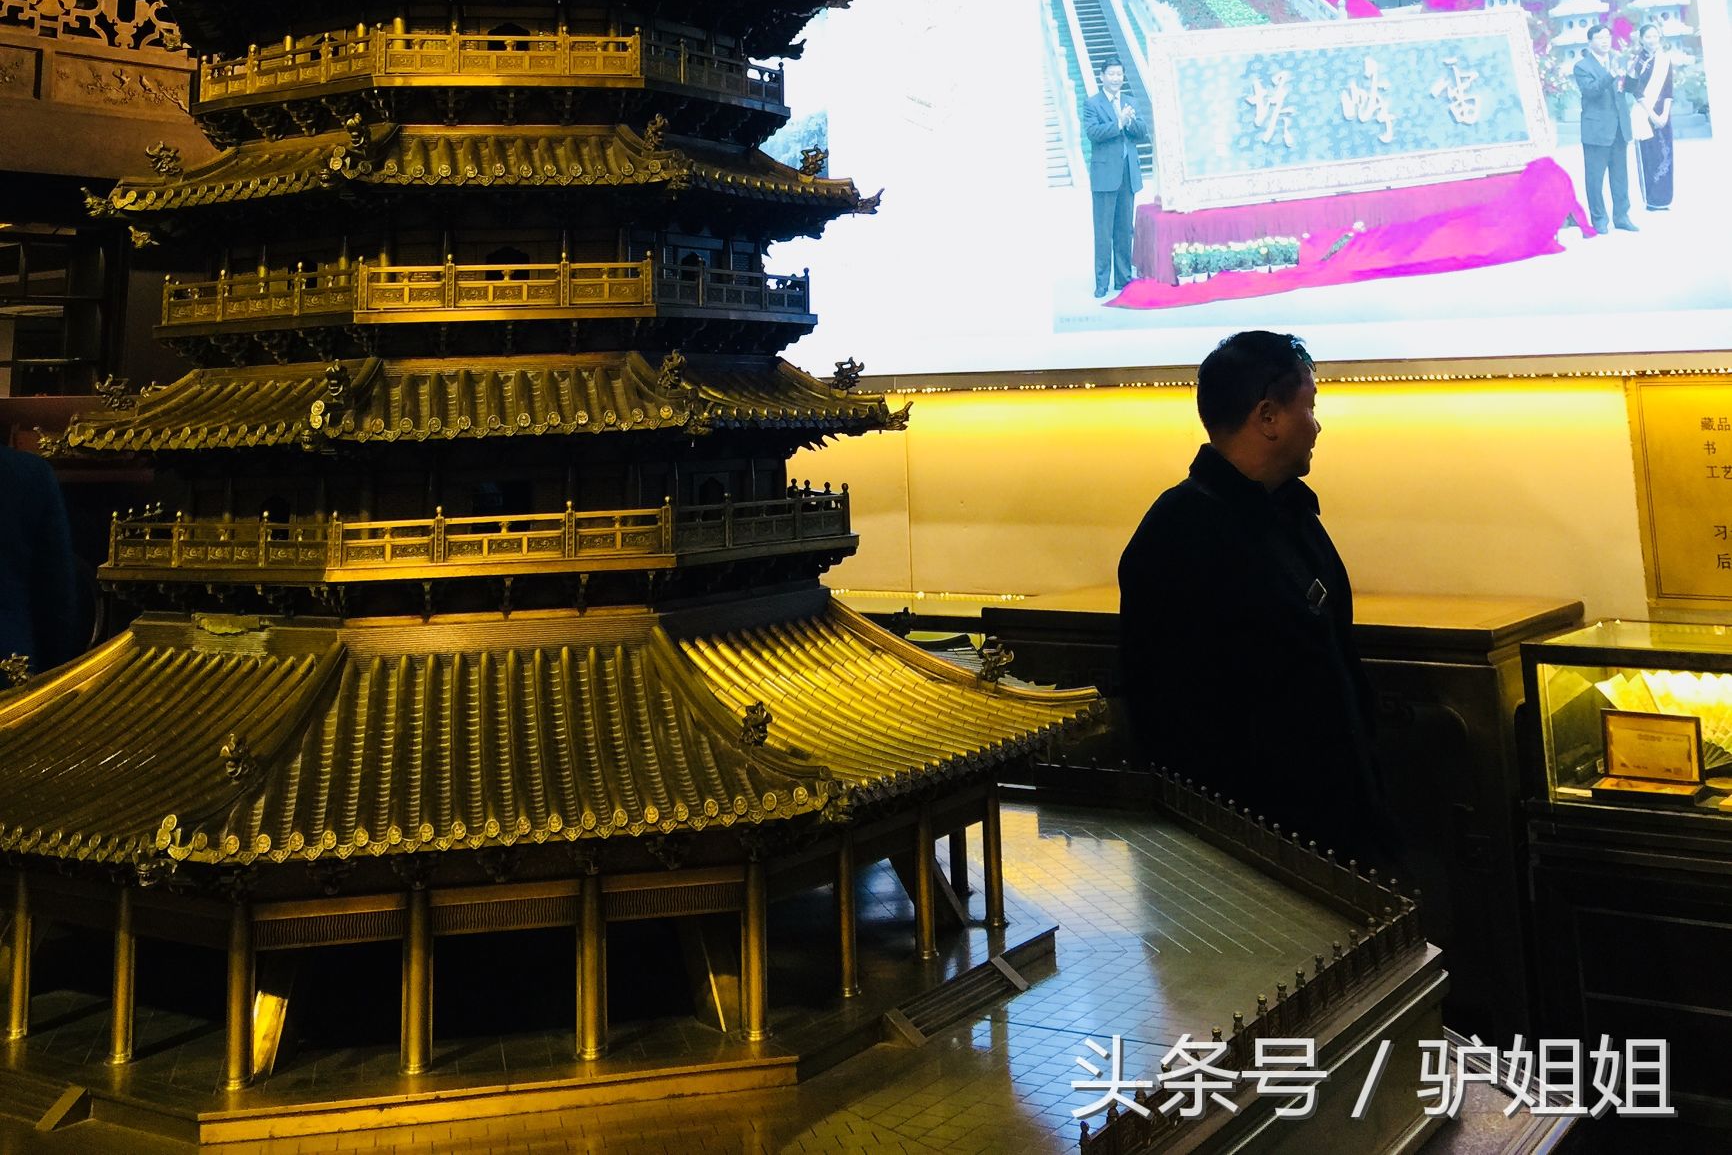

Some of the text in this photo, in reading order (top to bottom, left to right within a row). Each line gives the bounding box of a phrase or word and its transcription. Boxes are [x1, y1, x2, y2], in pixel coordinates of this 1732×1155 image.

[1700, 417, 1731, 431] 藏品
[1704, 440, 1717, 455] 书
[1716, 553, 1732, 570] 后
